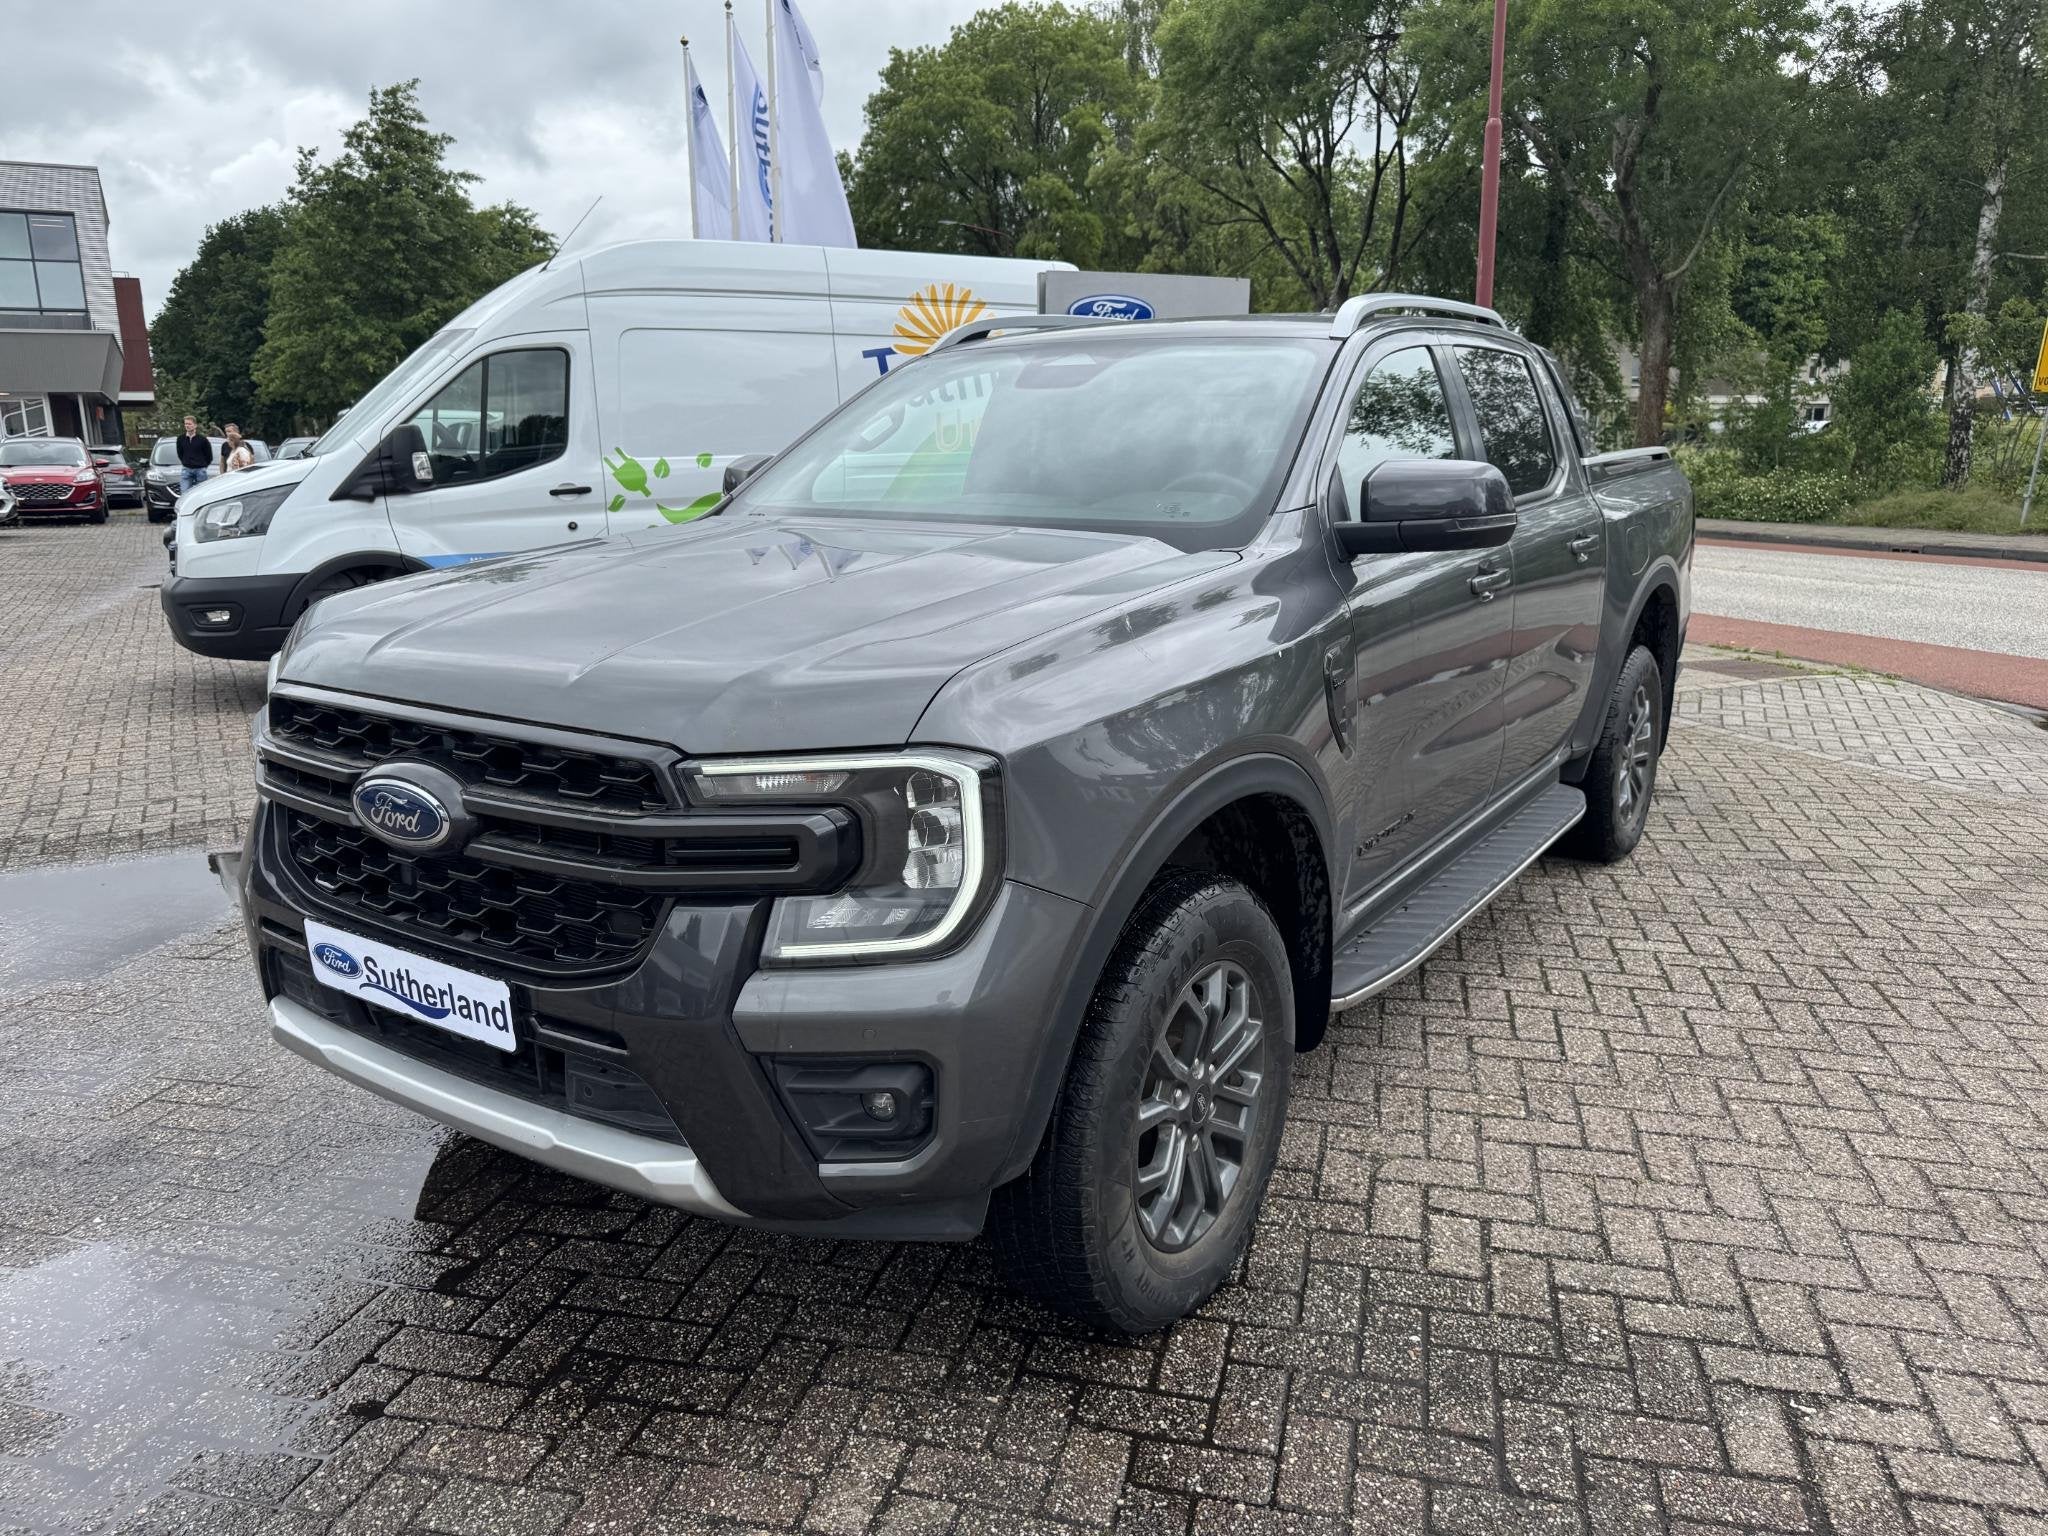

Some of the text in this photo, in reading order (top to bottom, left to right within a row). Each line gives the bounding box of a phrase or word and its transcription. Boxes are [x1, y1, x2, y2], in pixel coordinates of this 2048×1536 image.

[370, 791, 421, 833] Ford
[323, 947, 510, 1034] Ford Sutherland
